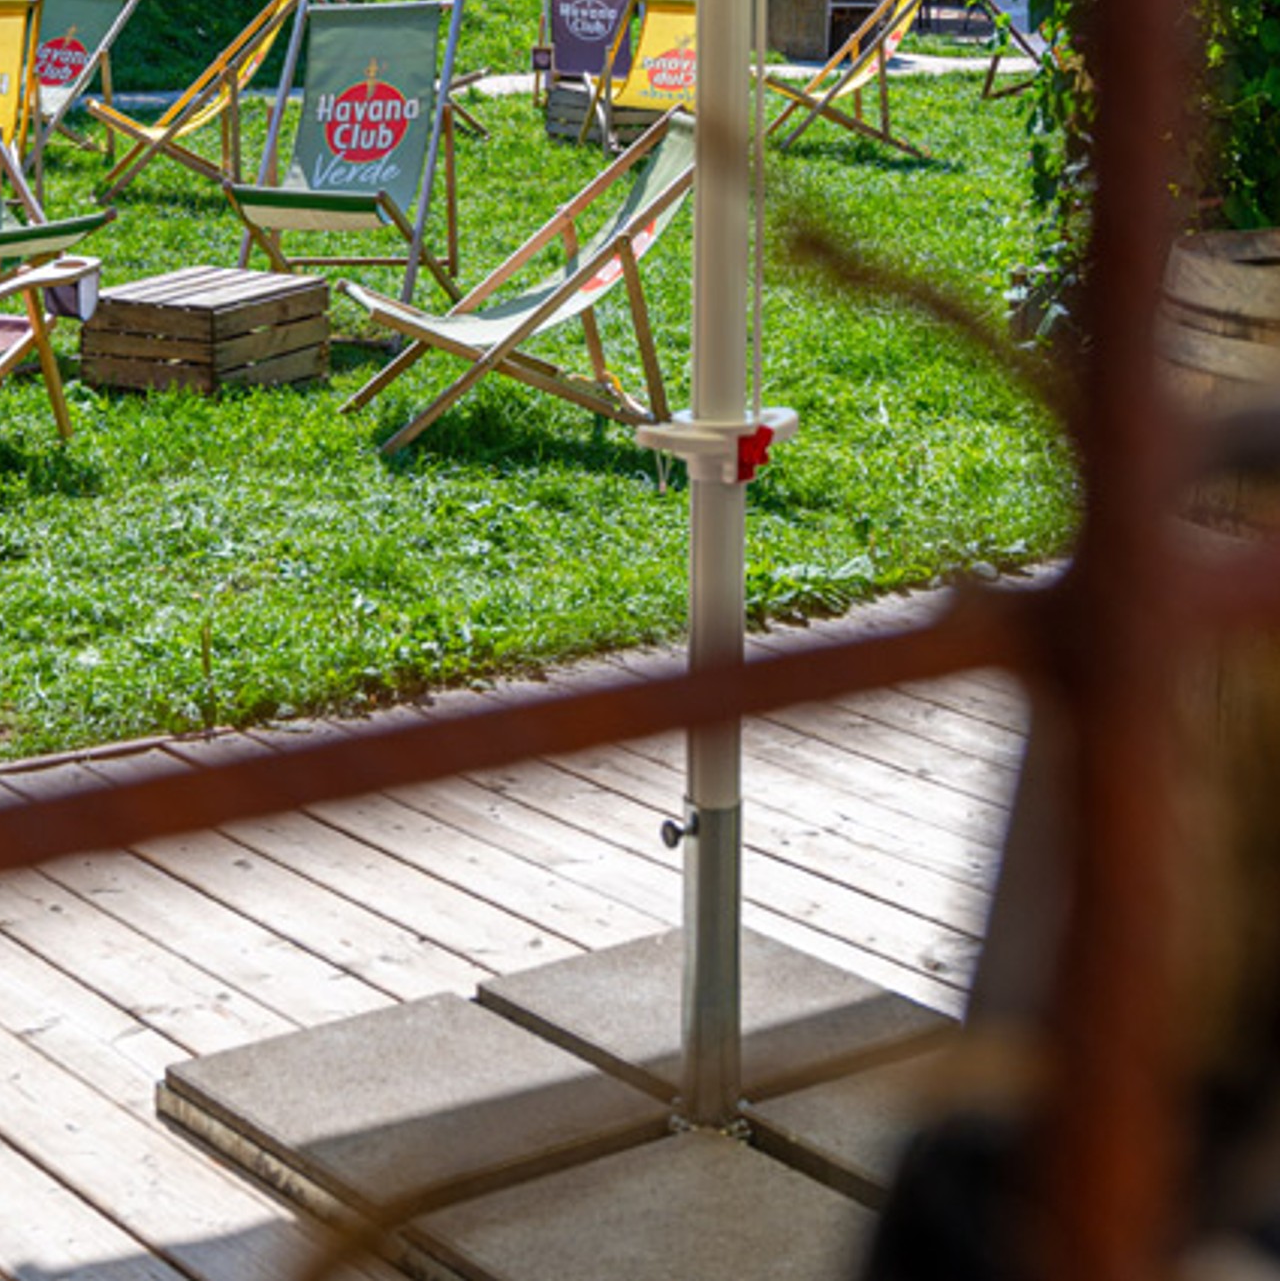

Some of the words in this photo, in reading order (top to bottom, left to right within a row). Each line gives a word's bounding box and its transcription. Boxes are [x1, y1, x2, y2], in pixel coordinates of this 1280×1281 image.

[316, 93, 420, 122] Havana
[333, 123, 394, 149] Club
[312, 150, 402, 188] Verde
